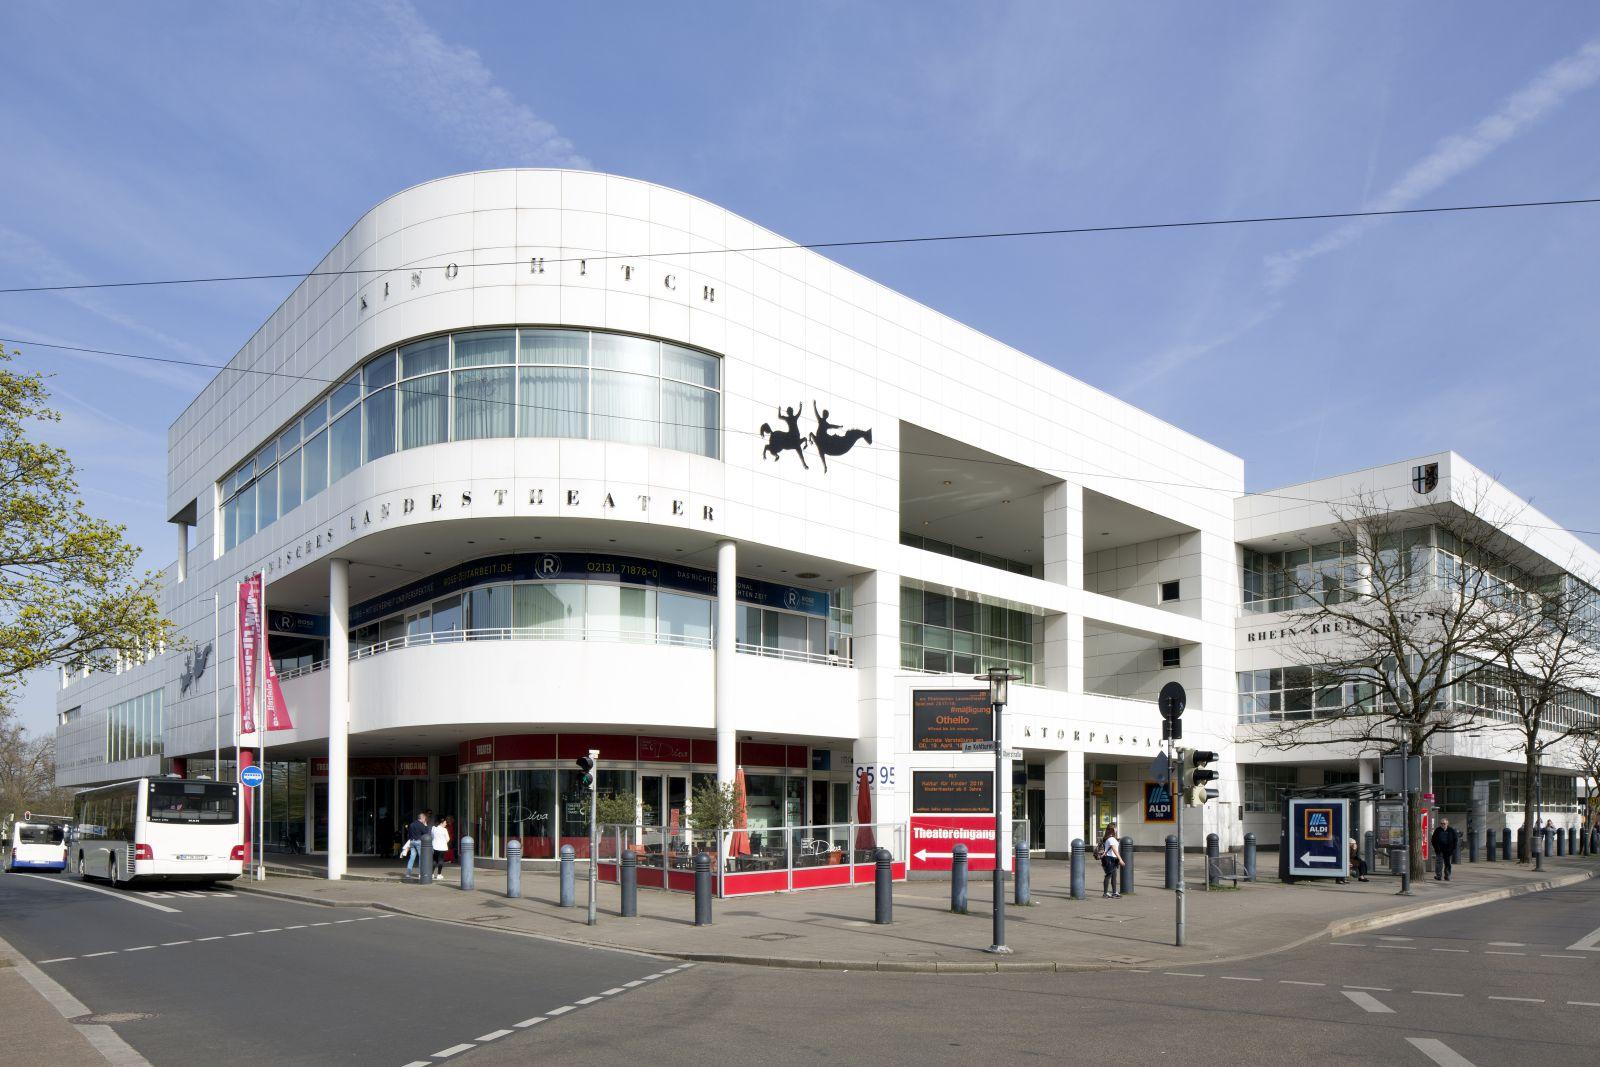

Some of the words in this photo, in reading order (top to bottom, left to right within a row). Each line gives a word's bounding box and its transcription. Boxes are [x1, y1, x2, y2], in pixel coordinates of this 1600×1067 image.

[360, 262, 459, 311] KINO
[530, 257, 715, 302] HITCH
[350, 489, 714, 531] LANDESTHEATER
[936, 715, 970, 724] Othello
[1149, 804, 1170, 813] ALDI
[913, 827, 996, 841] Theatereingang
